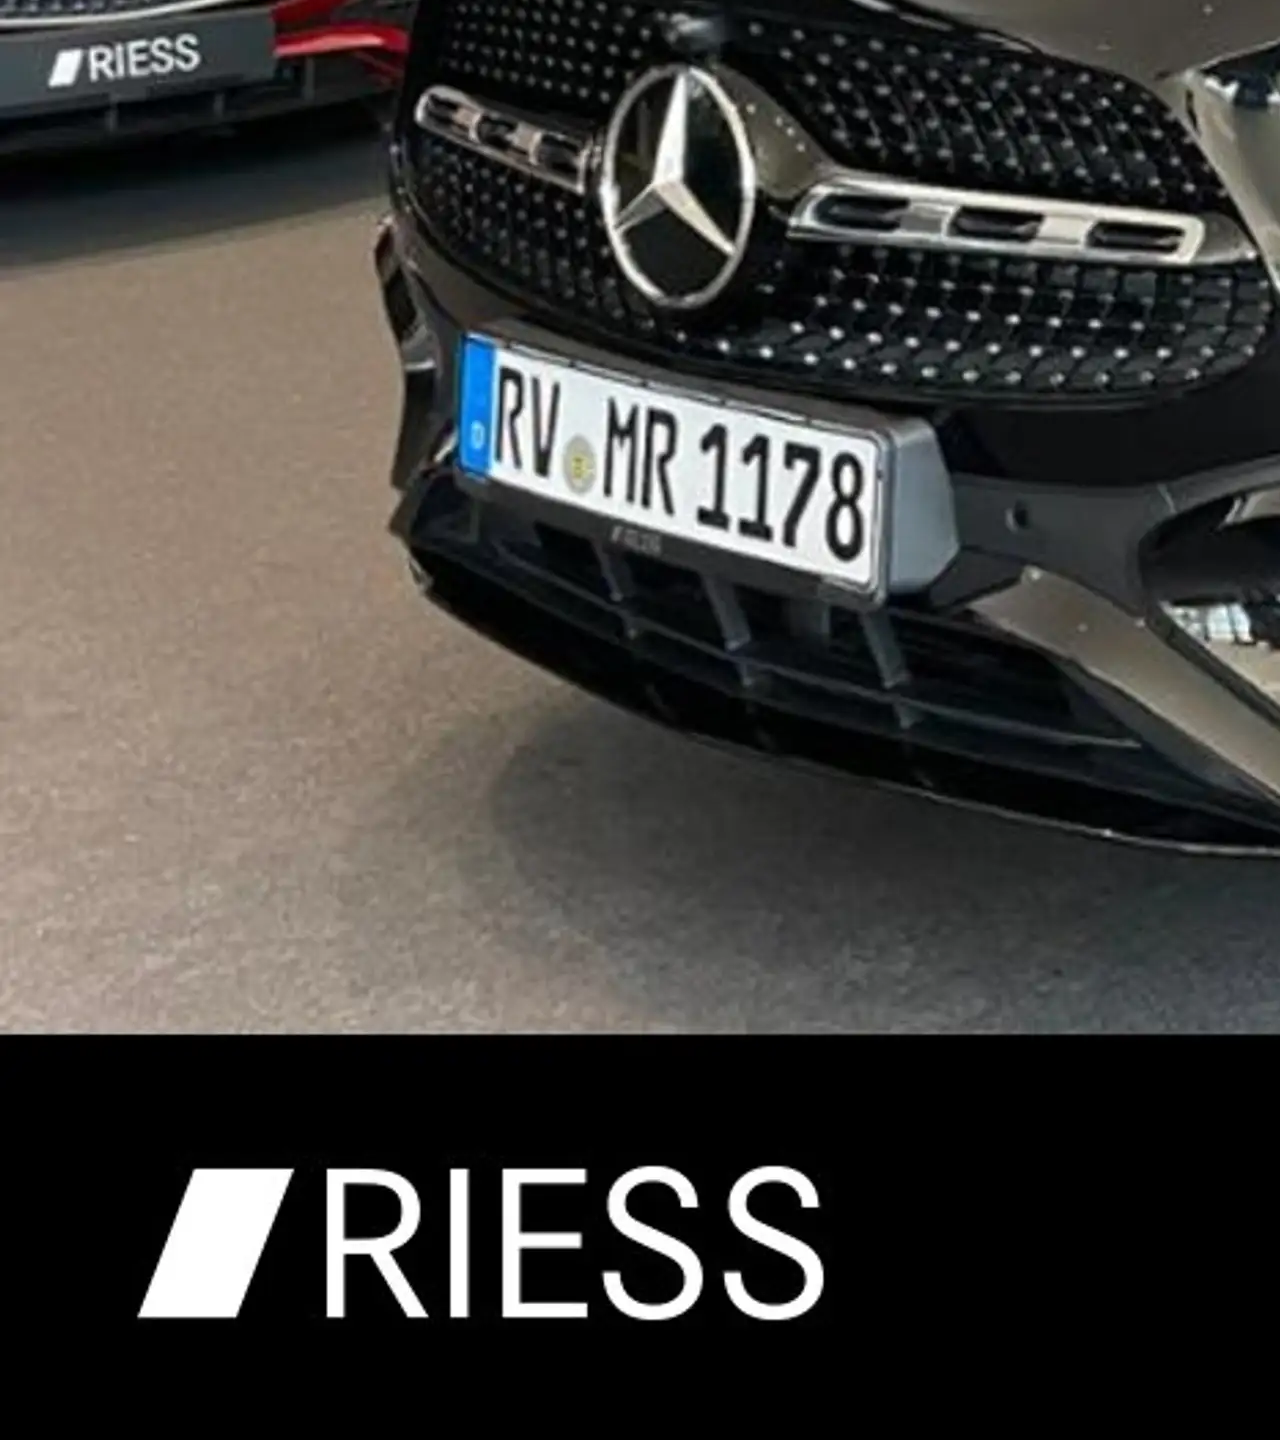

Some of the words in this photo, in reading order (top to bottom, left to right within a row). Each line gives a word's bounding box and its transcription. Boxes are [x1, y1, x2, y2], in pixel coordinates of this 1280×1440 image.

[89, 33, 201, 82] RIESS
[495, 366, 561, 479] RV
[602, 396, 679, 517] MR
[697, 422, 865, 564] 1178
